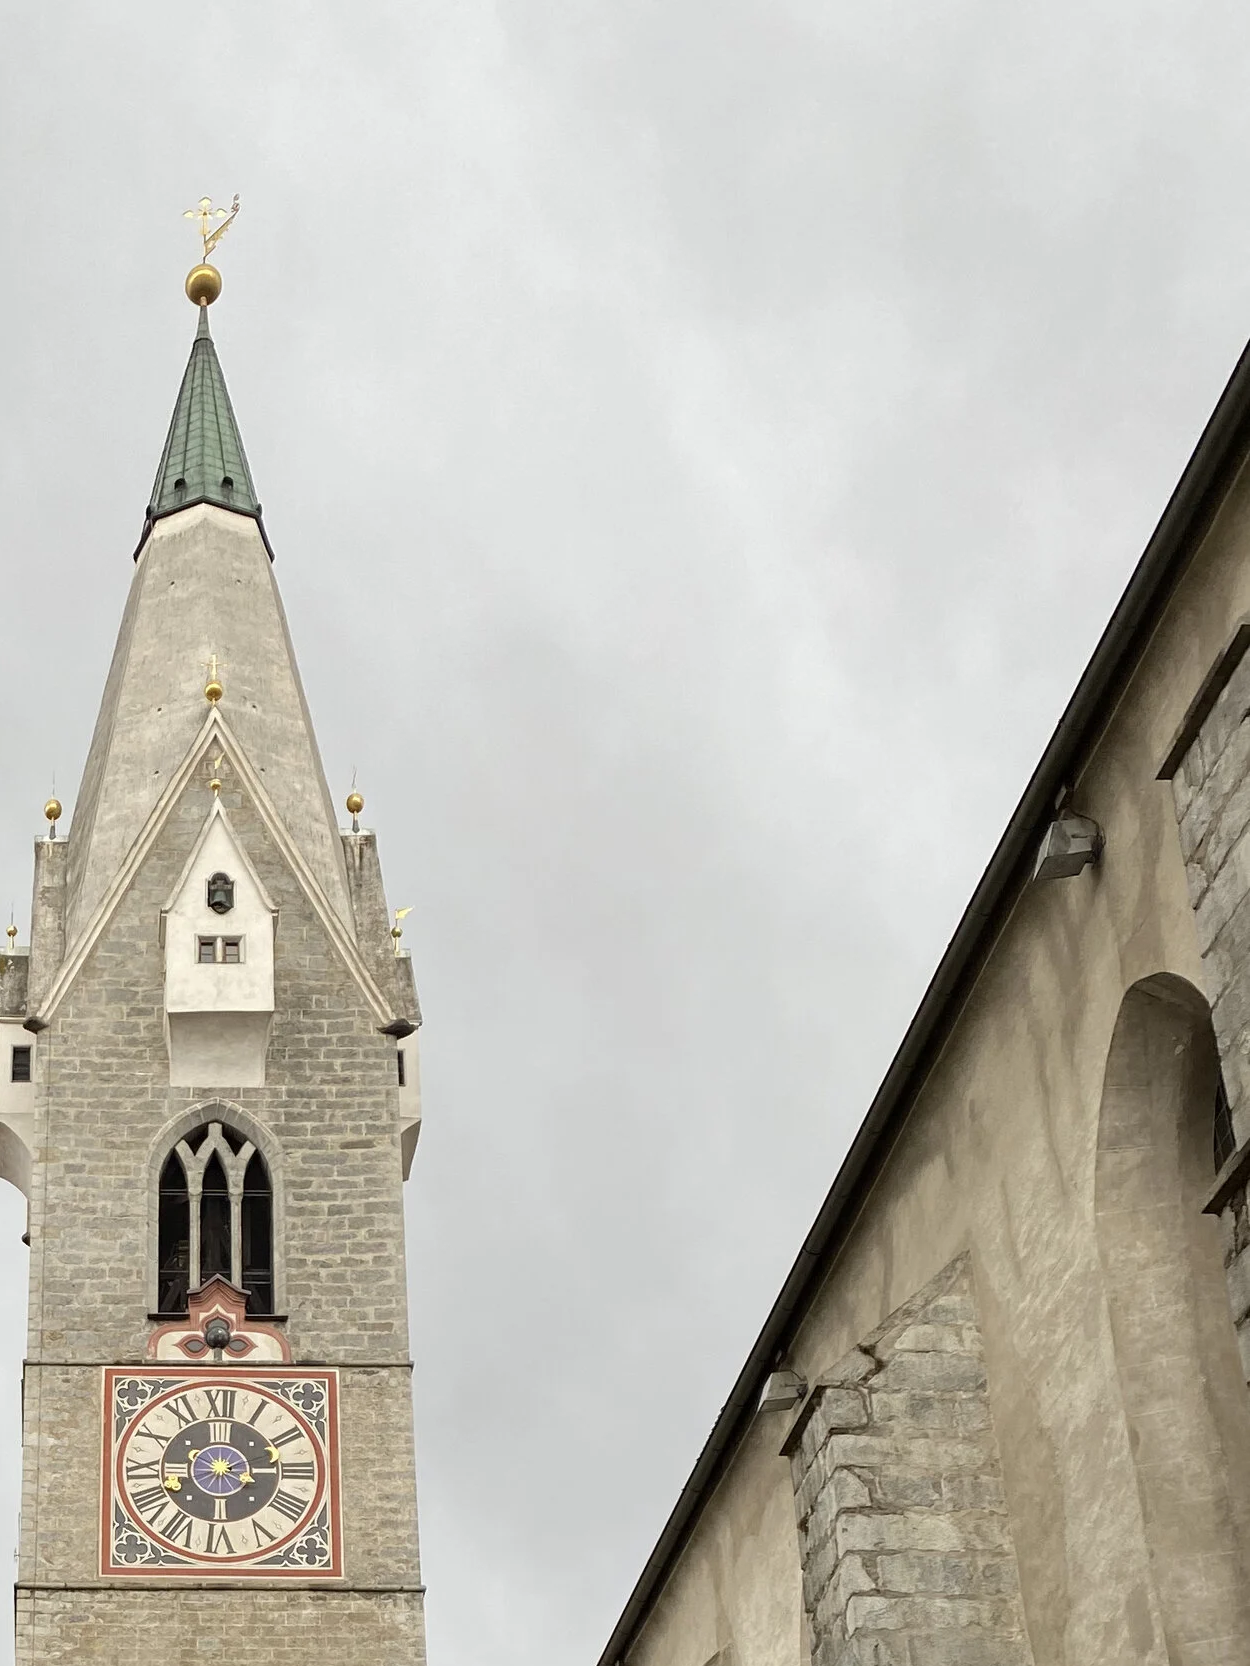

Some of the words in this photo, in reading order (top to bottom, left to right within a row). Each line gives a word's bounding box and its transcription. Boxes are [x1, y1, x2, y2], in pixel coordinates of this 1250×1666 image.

[163, 1394, 200, 1429] XI
[204, 1389, 238, 1419] XII
[247, 1398, 271, 1426] I
[134, 1422, 171, 1450] X
[270, 1424, 306, 1448] II
[281, 1461, 316, 1481] III
[131, 1487, 170, 1526] VIII
[159, 1510, 195, 1549] VII
[203, 1523, 238, 1555] VI
[251, 1518, 279, 1548] V
